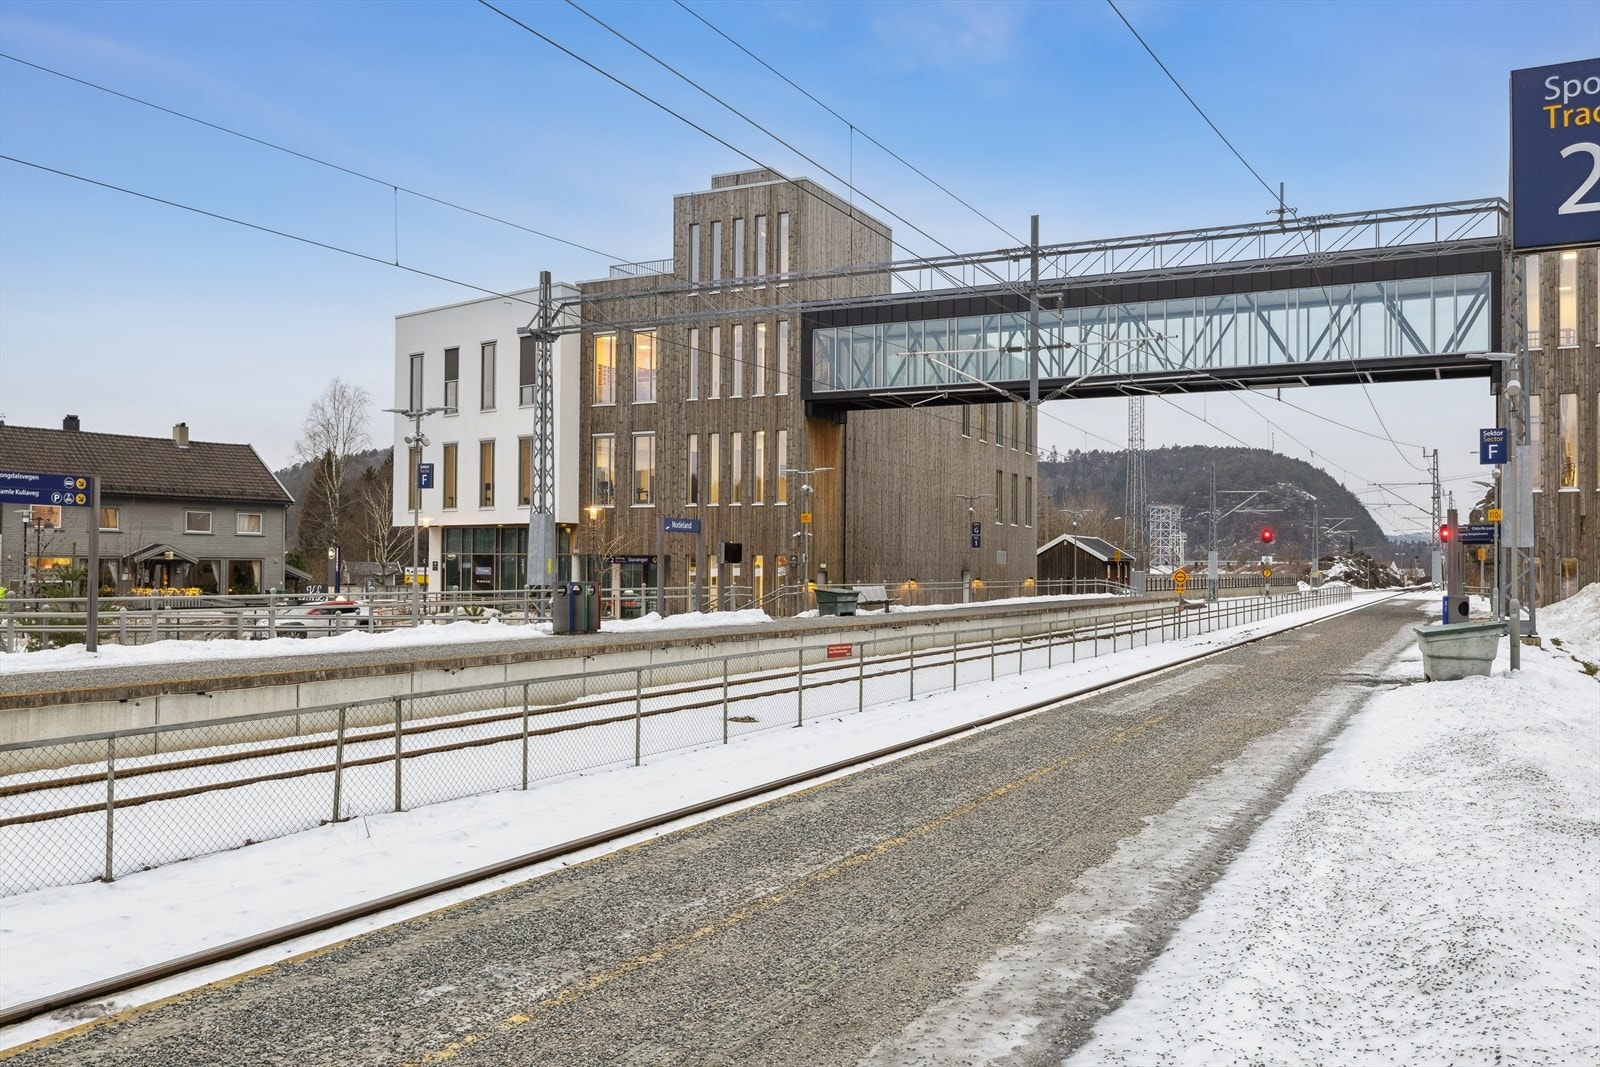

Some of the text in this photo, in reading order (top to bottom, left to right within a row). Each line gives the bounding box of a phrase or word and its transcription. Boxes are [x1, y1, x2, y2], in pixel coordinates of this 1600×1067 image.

[1558, 142, 1600, 215] 2
[1489, 444, 1498, 459] F
[422, 474, 427, 485] F
[671, 521, 692, 529] Nodeland
